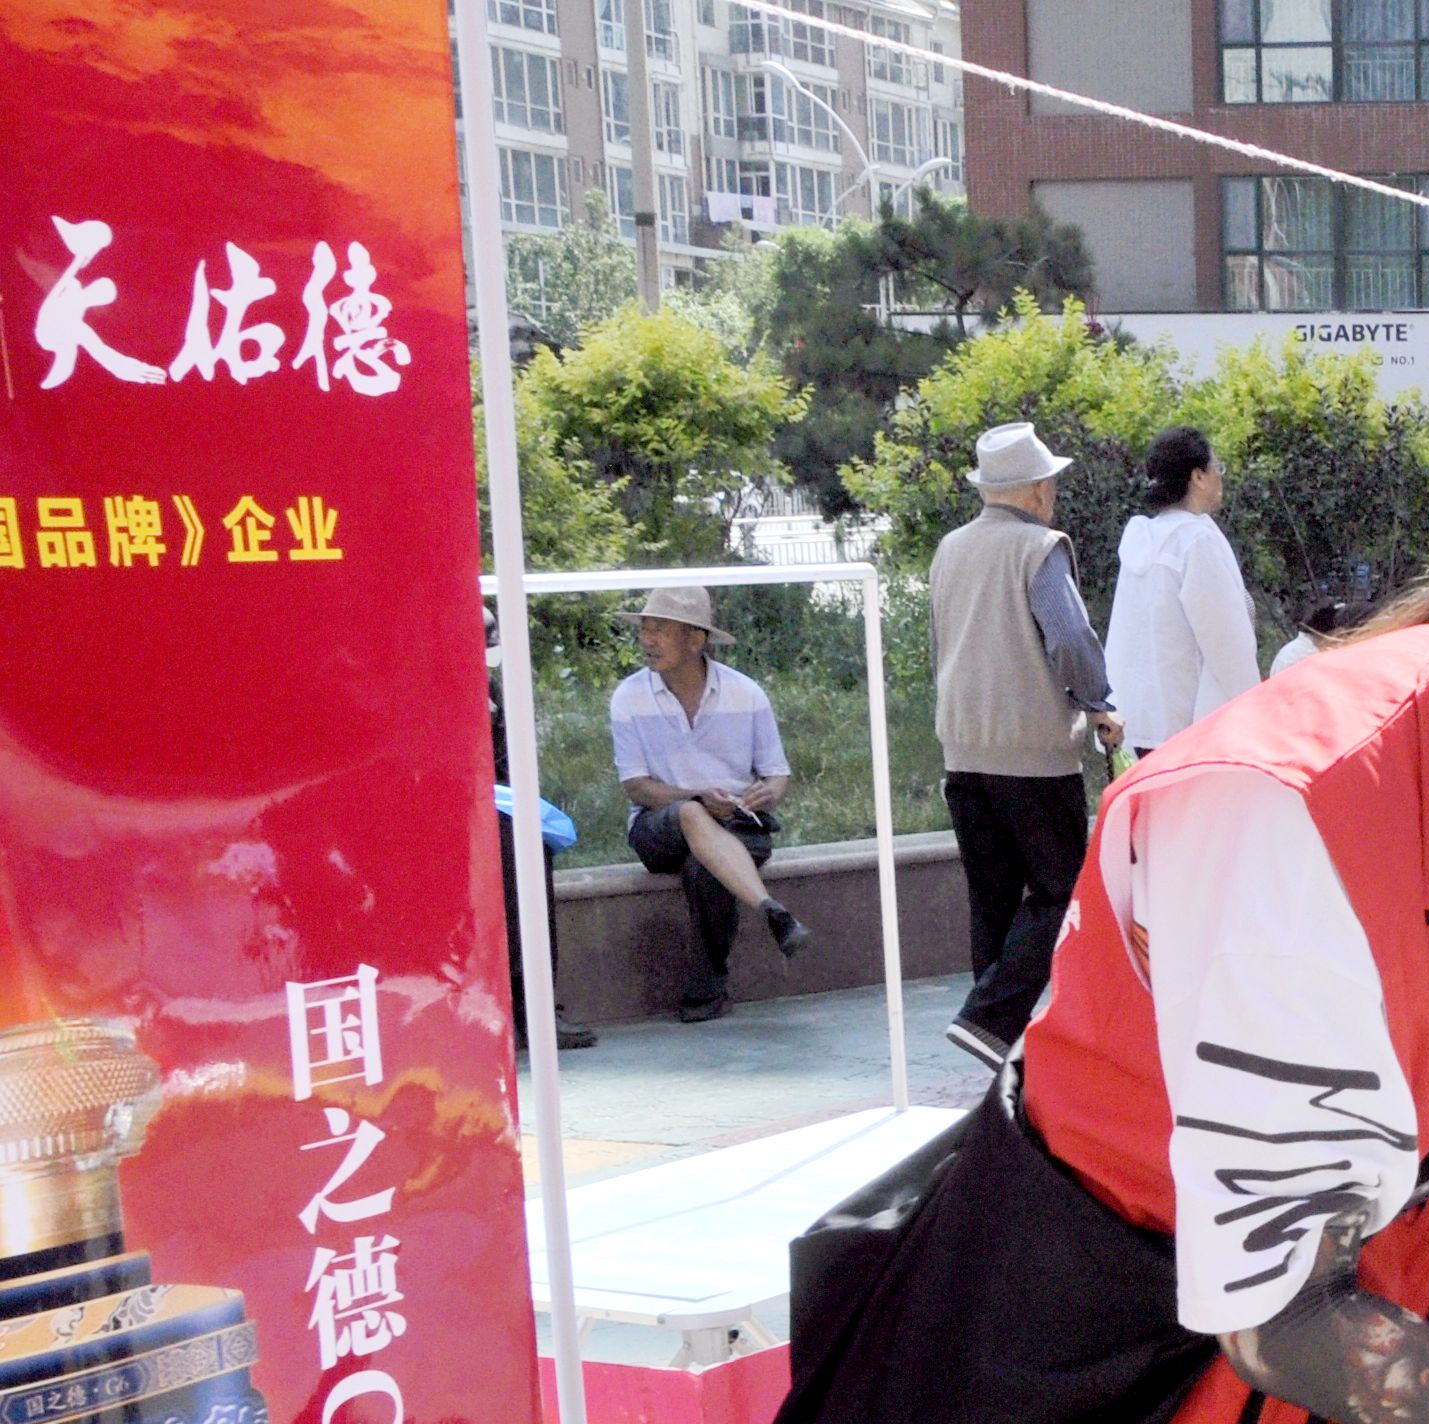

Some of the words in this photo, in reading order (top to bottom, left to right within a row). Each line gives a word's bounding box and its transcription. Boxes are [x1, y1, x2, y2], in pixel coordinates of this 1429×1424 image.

[35, 215, 411, 396] 天佑德
[1294, 324, 1408, 342] GIGABYTE
[1390, 356, 1415, 366] NO.1
